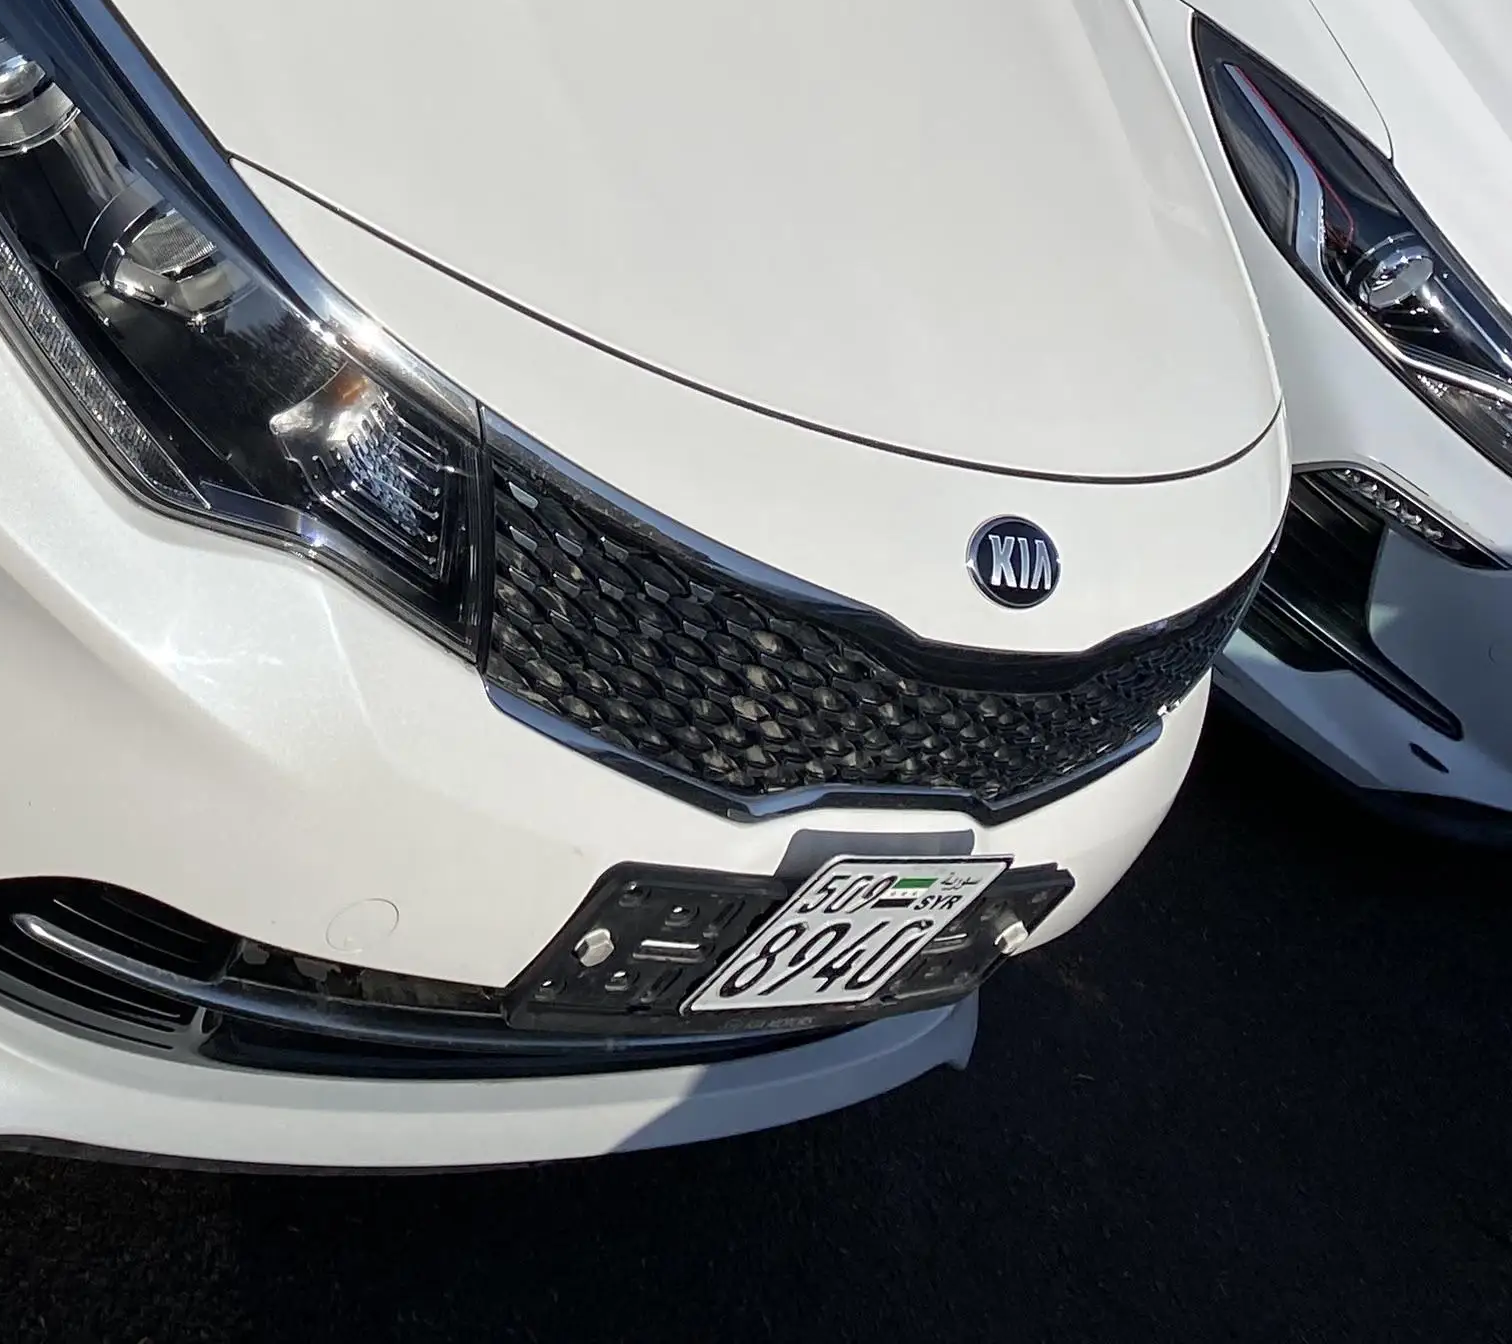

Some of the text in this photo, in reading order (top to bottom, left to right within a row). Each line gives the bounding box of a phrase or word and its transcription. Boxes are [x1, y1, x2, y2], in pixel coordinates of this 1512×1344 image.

[988, 534, 1052, 590] KIA
[798, 875, 898, 914] 509
[913, 894, 963, 911] SYR
[719, 919, 935, 998] 8940
